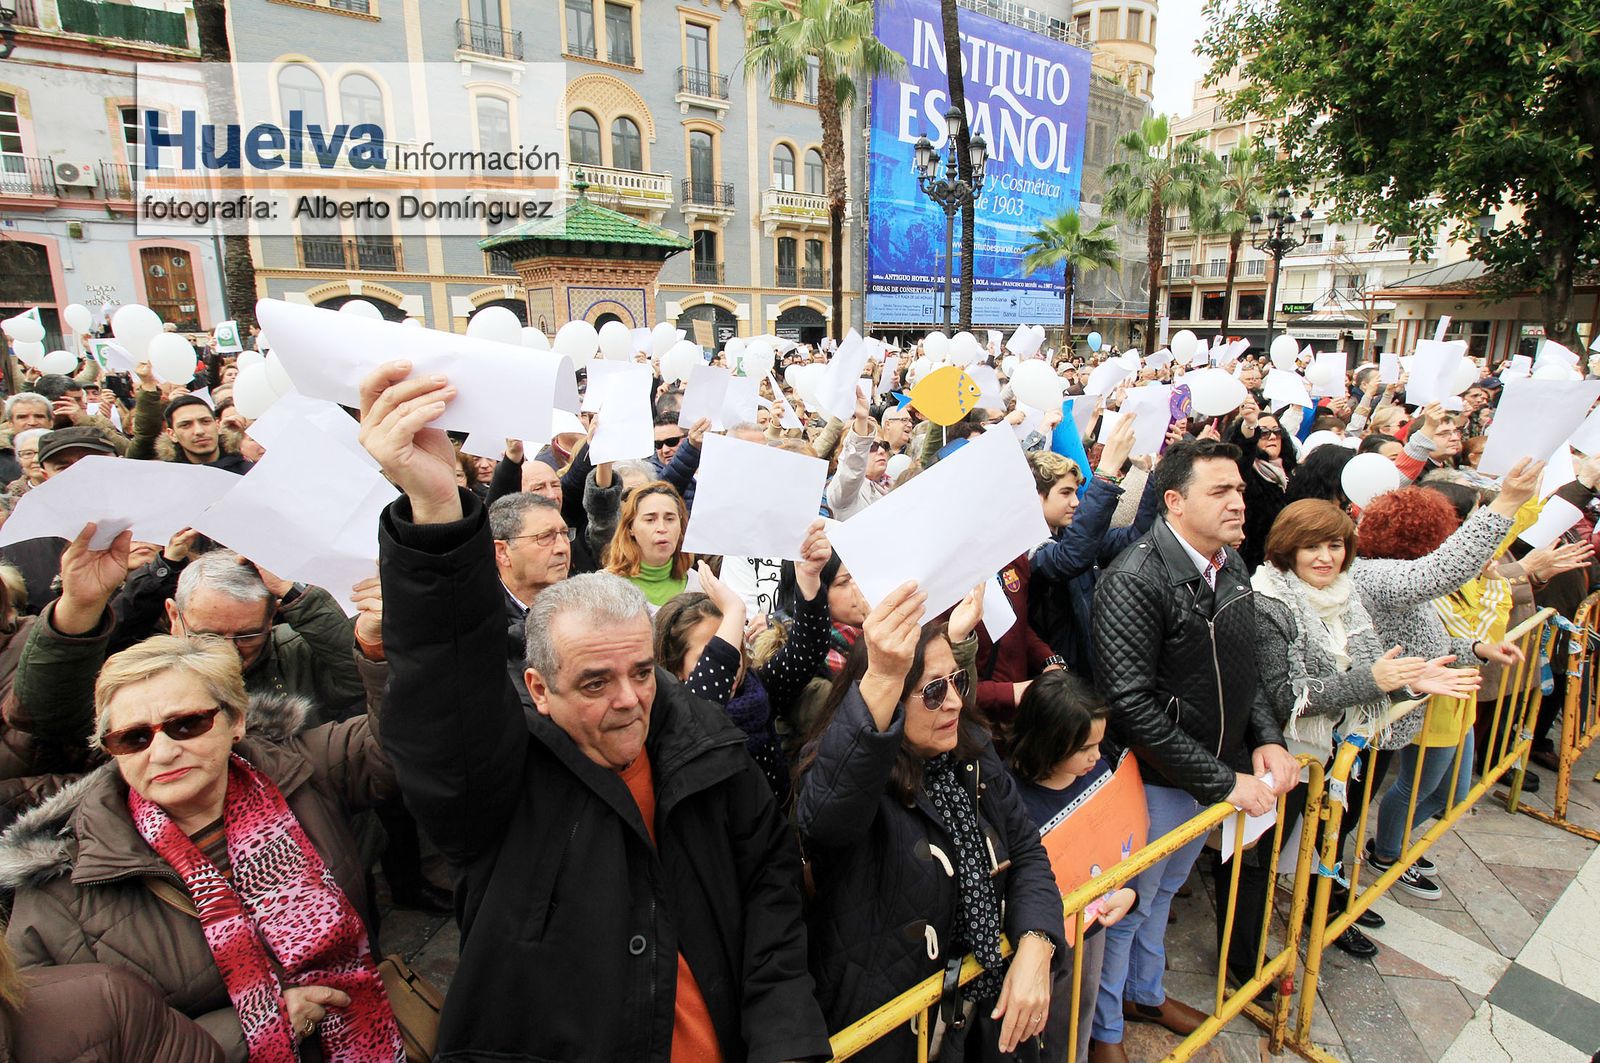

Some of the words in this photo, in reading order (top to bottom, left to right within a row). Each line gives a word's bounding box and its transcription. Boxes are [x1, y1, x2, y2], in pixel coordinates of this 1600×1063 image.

[988, 174, 999, 192] y
[1001, 173, 1061, 198] Cosmética
[992, 195, 1024, 216] 1903
[872, 285, 890, 293] OBRAS
[900, 286, 936, 294] CONSERVACIÓ
